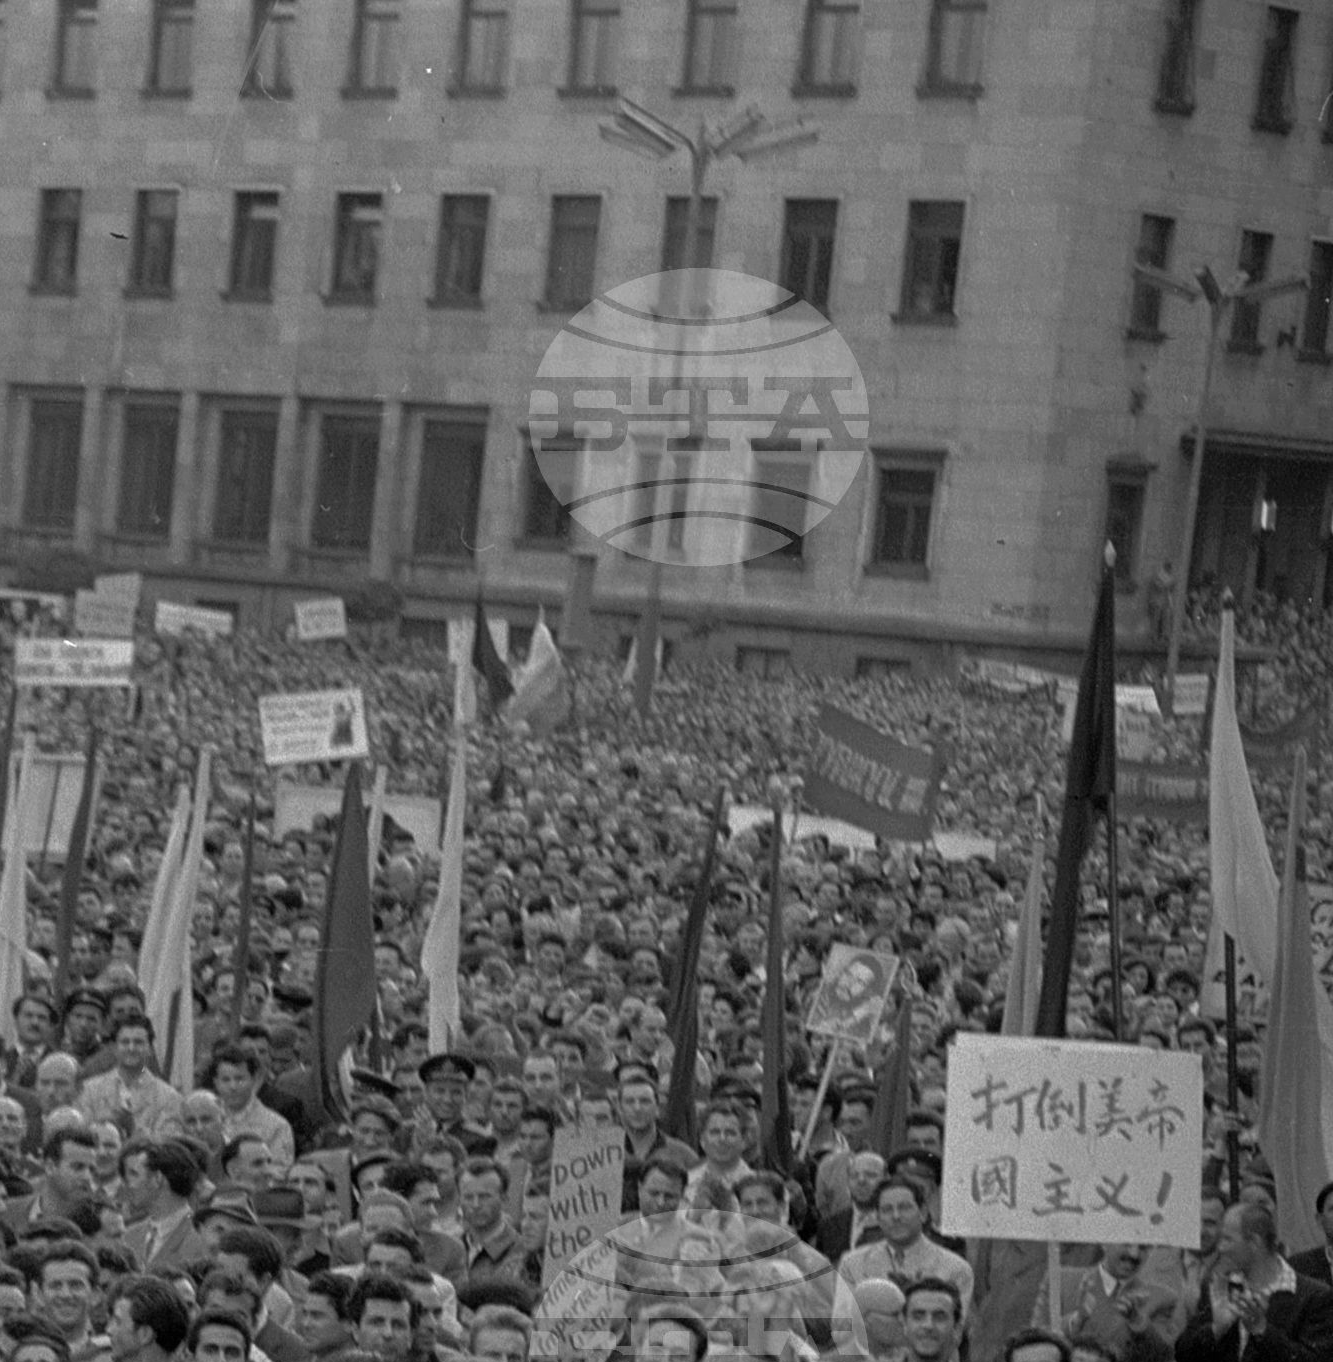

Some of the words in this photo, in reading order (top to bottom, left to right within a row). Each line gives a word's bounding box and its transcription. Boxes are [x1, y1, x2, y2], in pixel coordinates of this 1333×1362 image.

[971, 1075, 1186, 1149] 打倒美帝
[550, 1184, 609, 1221] with
[548, 1224, 592, 1259] the
